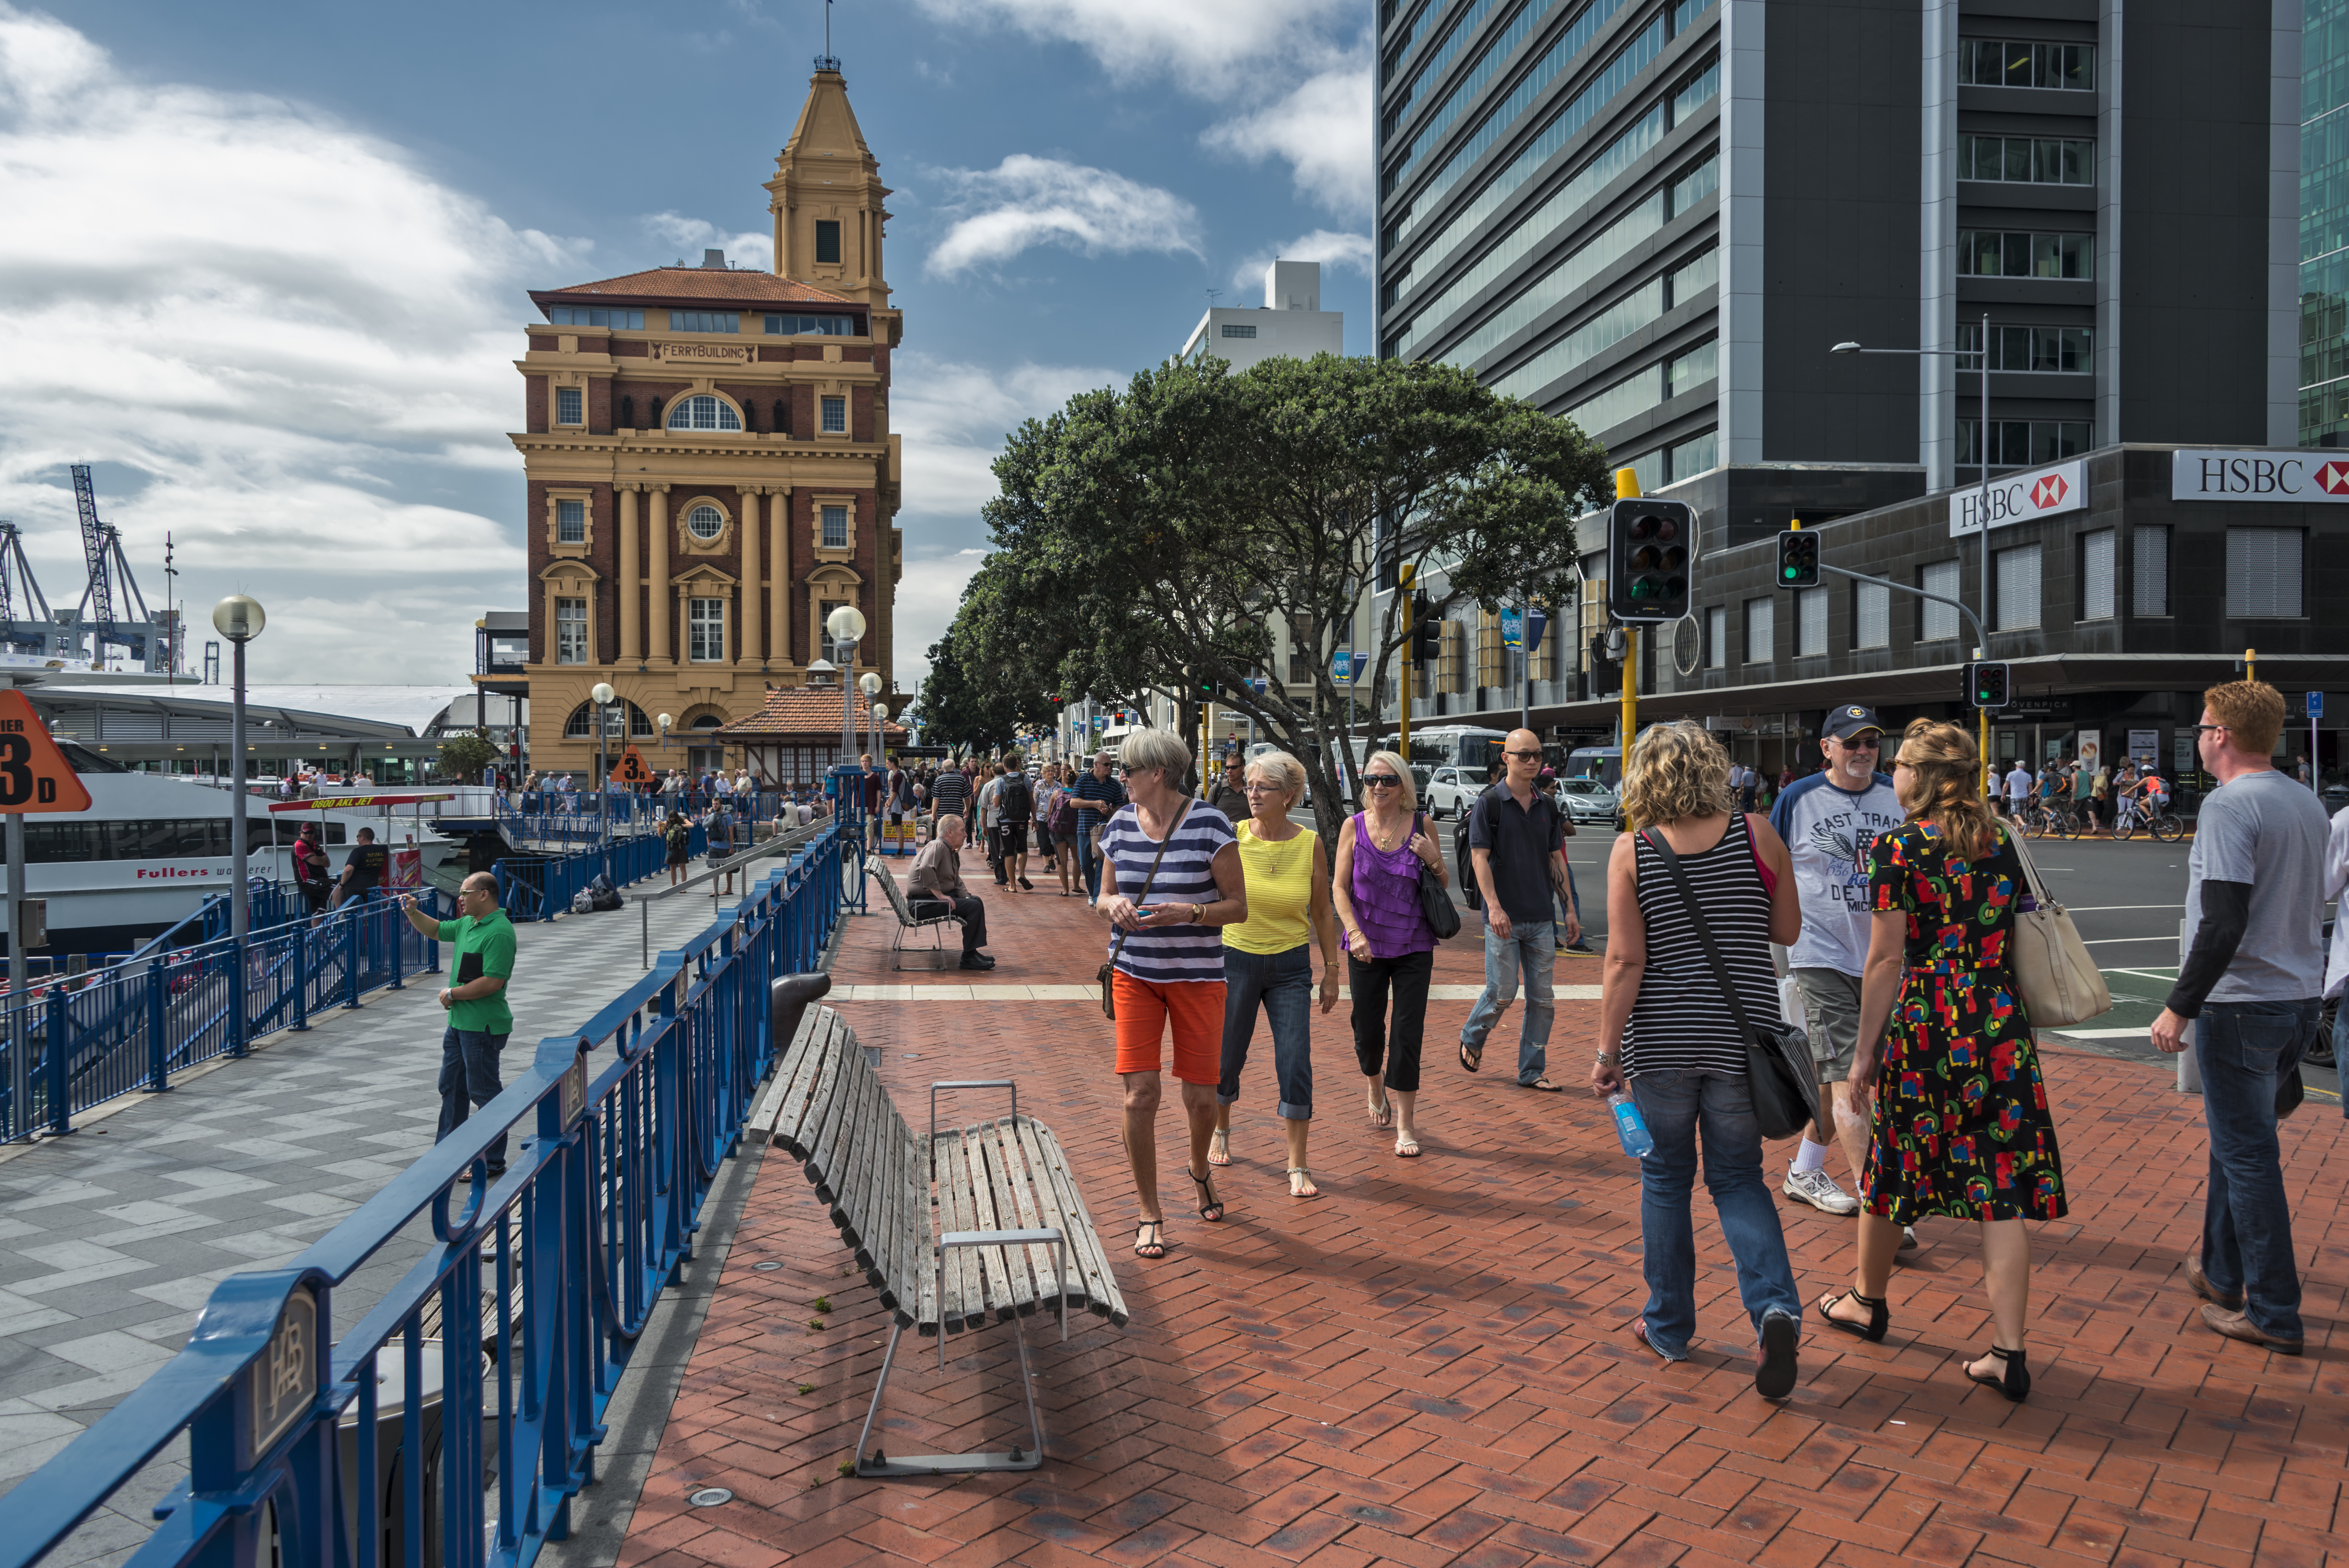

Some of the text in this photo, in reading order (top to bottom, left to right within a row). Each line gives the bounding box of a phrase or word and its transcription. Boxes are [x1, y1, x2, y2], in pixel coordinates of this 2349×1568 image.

[2197, 458, 2303, 494] HSBC
[1960, 481, 2023, 528] HSBC
[0, 719, 24, 732] IER
[624, 758, 645, 780] 3 B
[38, 777, 56, 804] D
[311, 797, 374, 809] 0800 AKL JET
[1001, 825, 1010, 836] 5
[1812, 812, 1852, 837] FAST
[1829, 857, 1845, 869] Est
[137, 867, 208, 879] Fullers
